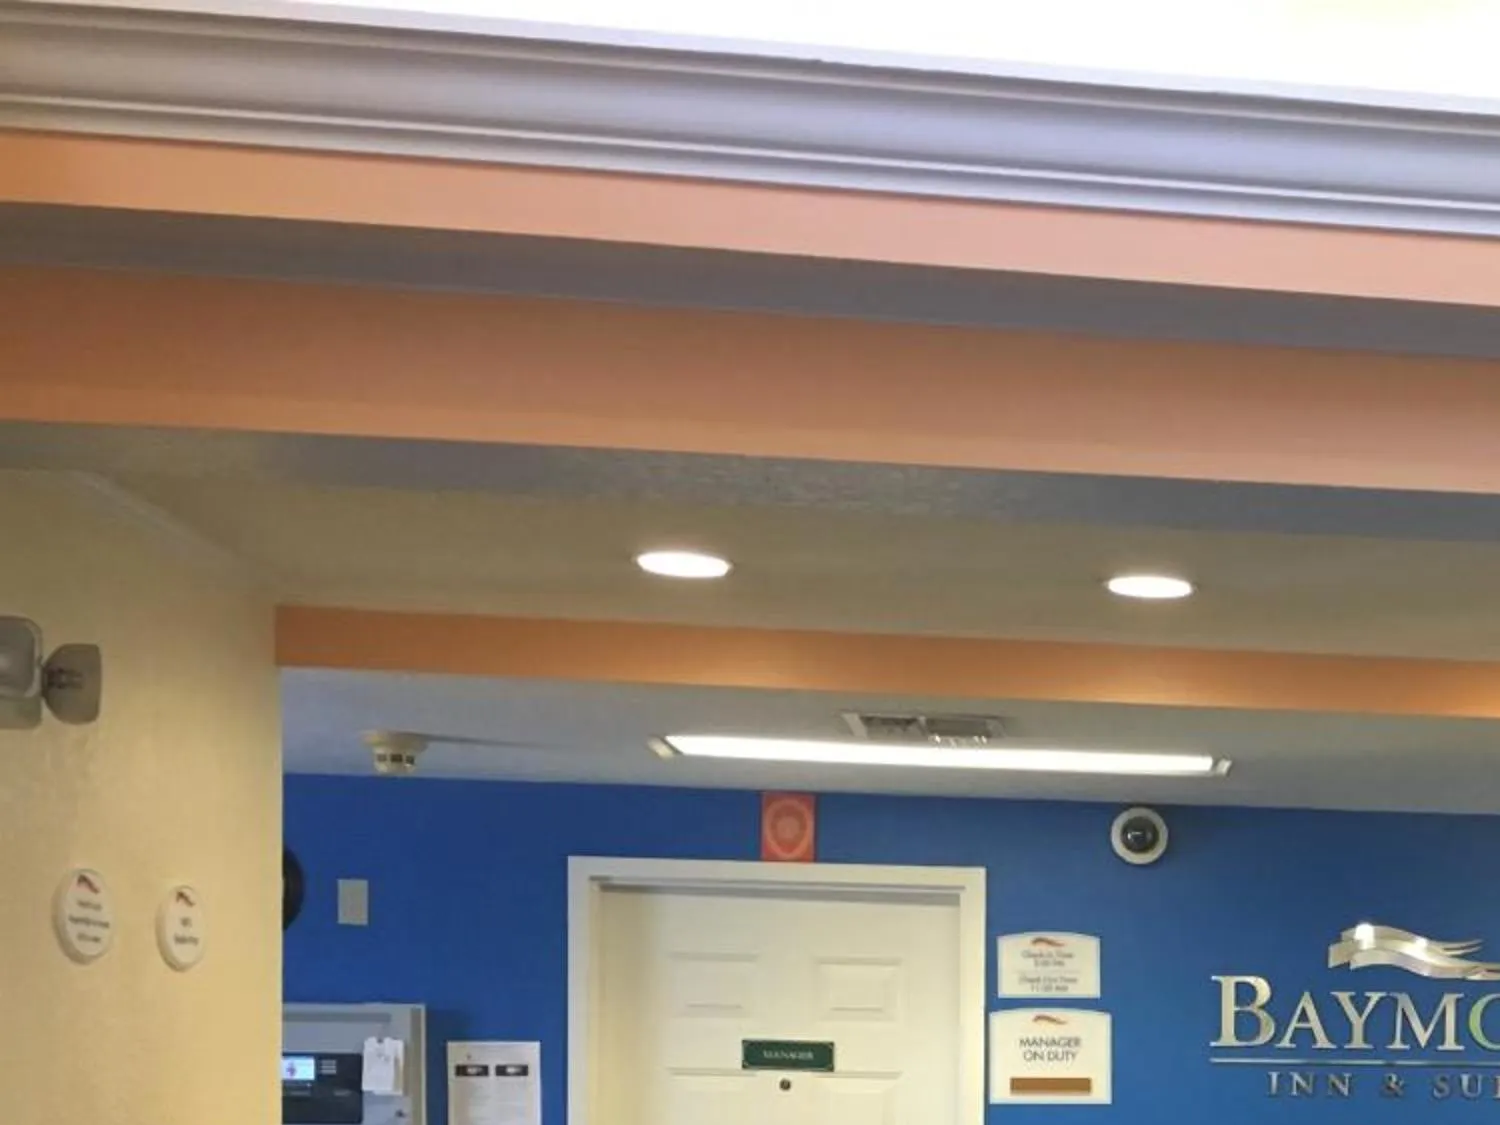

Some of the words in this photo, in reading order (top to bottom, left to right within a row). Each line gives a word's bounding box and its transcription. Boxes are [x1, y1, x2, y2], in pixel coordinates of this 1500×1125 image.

[1019, 1036, 1082, 1050] MANAGER
[1023, 1050, 1045, 1063] ON
[1047, 1050, 1079, 1063] DUTY
[1267, 1071, 1353, 1097] INN
[1383, 1073, 1405, 1097] &
